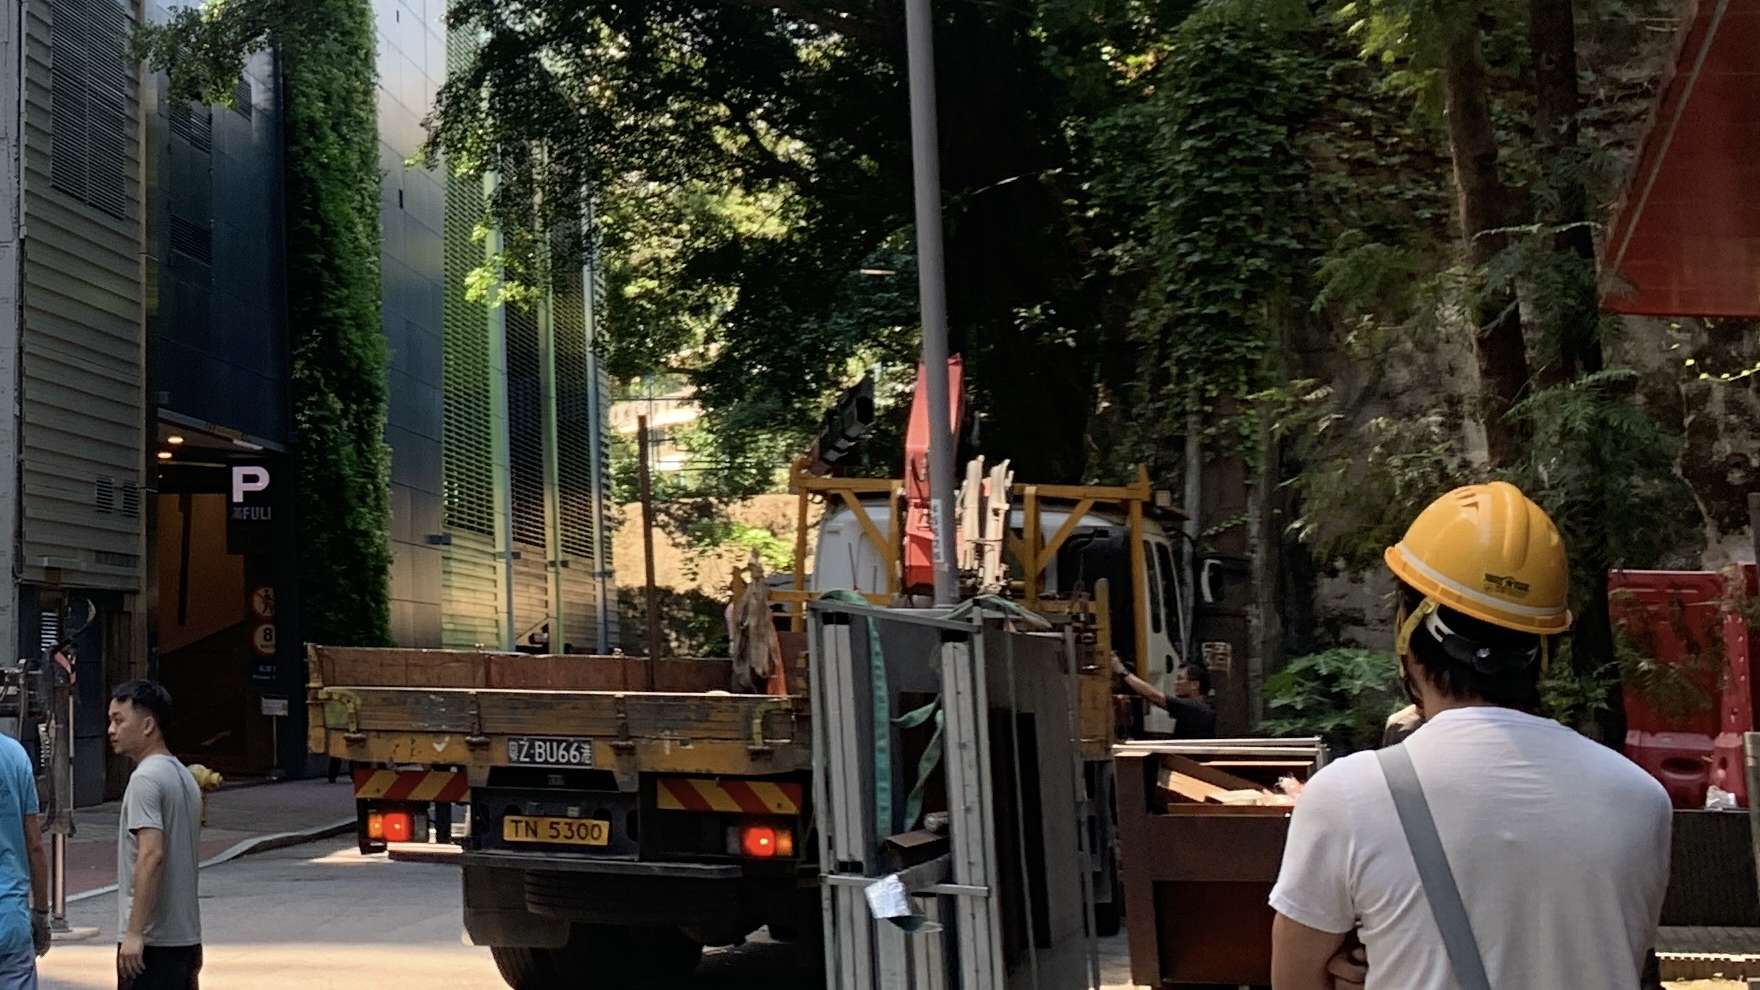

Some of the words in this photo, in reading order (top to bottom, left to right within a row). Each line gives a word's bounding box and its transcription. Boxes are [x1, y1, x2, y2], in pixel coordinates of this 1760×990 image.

[232, 466, 270, 503] P
[263, 627, 273, 642] 8
[511, 819, 538, 838] TN
[548, 821, 602, 841] 5300
